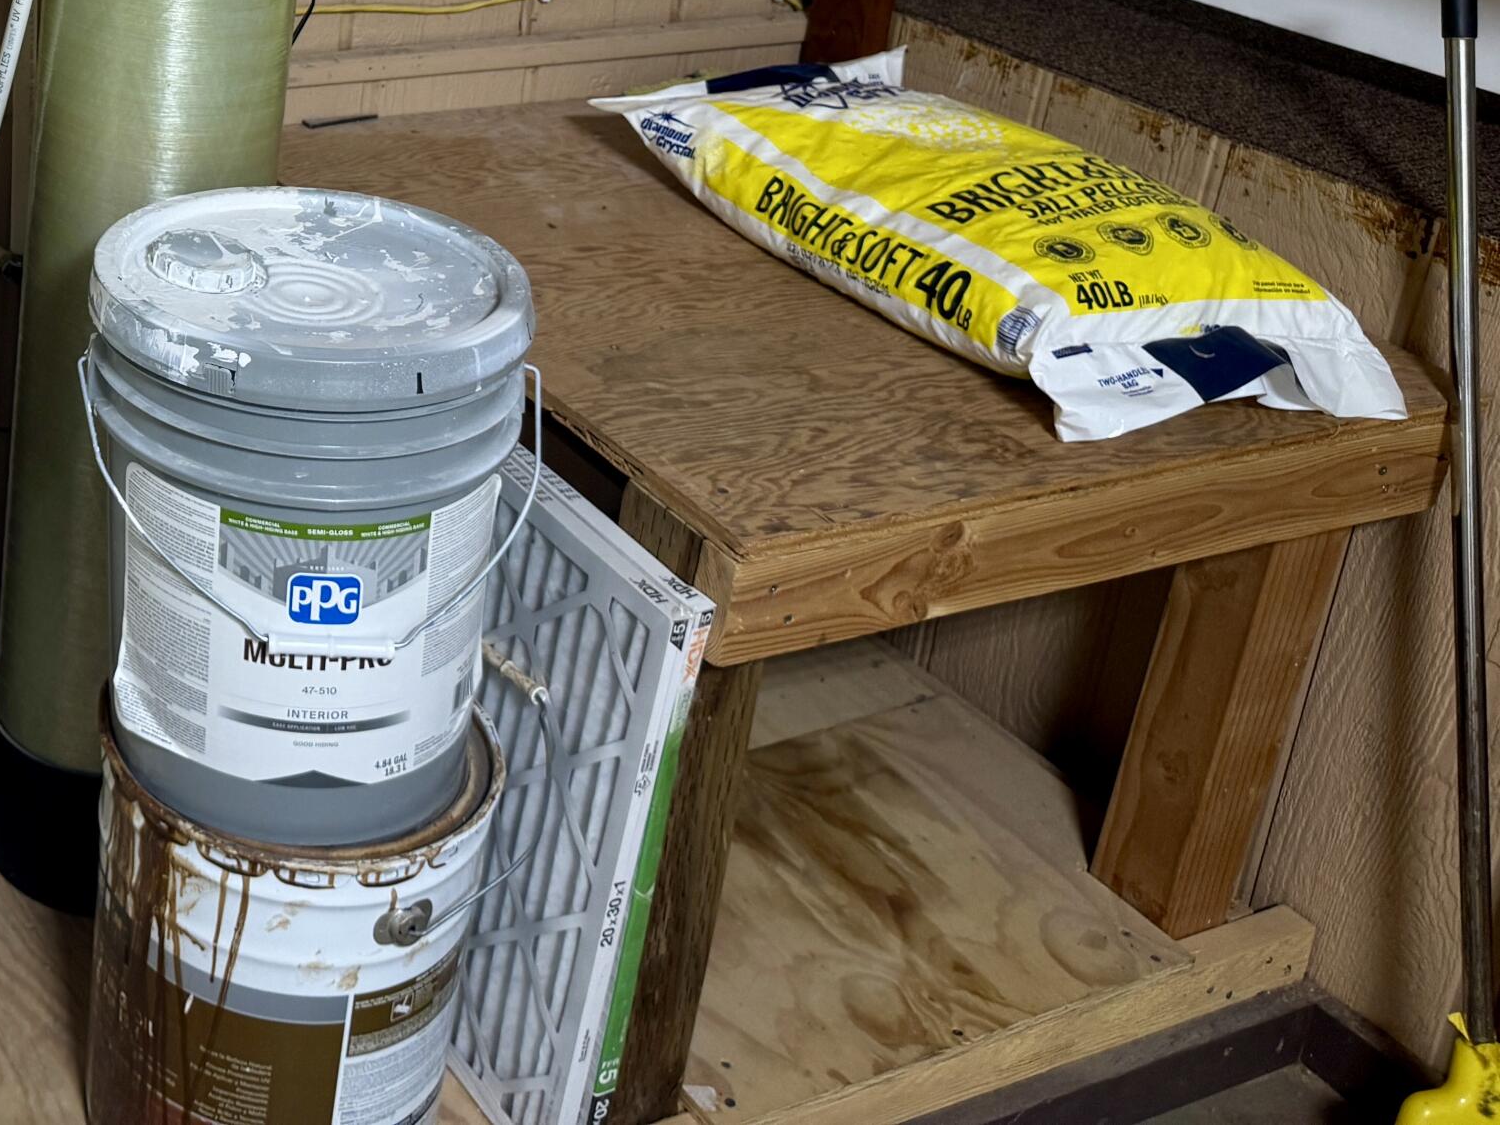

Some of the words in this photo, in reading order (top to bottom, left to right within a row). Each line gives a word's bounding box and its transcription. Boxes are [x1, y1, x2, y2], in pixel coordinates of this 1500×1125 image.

[11, 8, 21, 23] UV
[640, 117, 692, 144] Diamond
[655, 135, 697, 160] Crystal
[1016, 192, 1078, 219] SALT
[1063, 200, 1117, 221] WATER
[1068, 272, 1088, 284] NET
[1088, 269, 1104, 281] WT
[915, 261, 972, 321] 40
[956, 304, 973, 331] LB
[1121, 379, 1140, 390] BAG
[228, 518, 244, 526] WHITE
[245, 516, 281, 528] COMMERCIAL
[378, 520, 411, 531] COMMERCIAL
[307, 528, 354, 536] SEMI-GLOSS
[361, 530, 378, 538] WHITE
[629, 577, 669, 605] HDX
[661, 576, 698, 600] HDX
[291, 579, 359, 621] PPG
[701, 612, 712, 623] 5
[673, 623, 686, 634] 5
[301, 686, 338, 695] 47-510
[286, 708, 350, 720] INTERIOR
[393, 752, 407, 764] GAL
[402, 762, 407, 771] L
[598, 1068, 618, 1085] 5
[593, 1098, 610, 1125] 20
